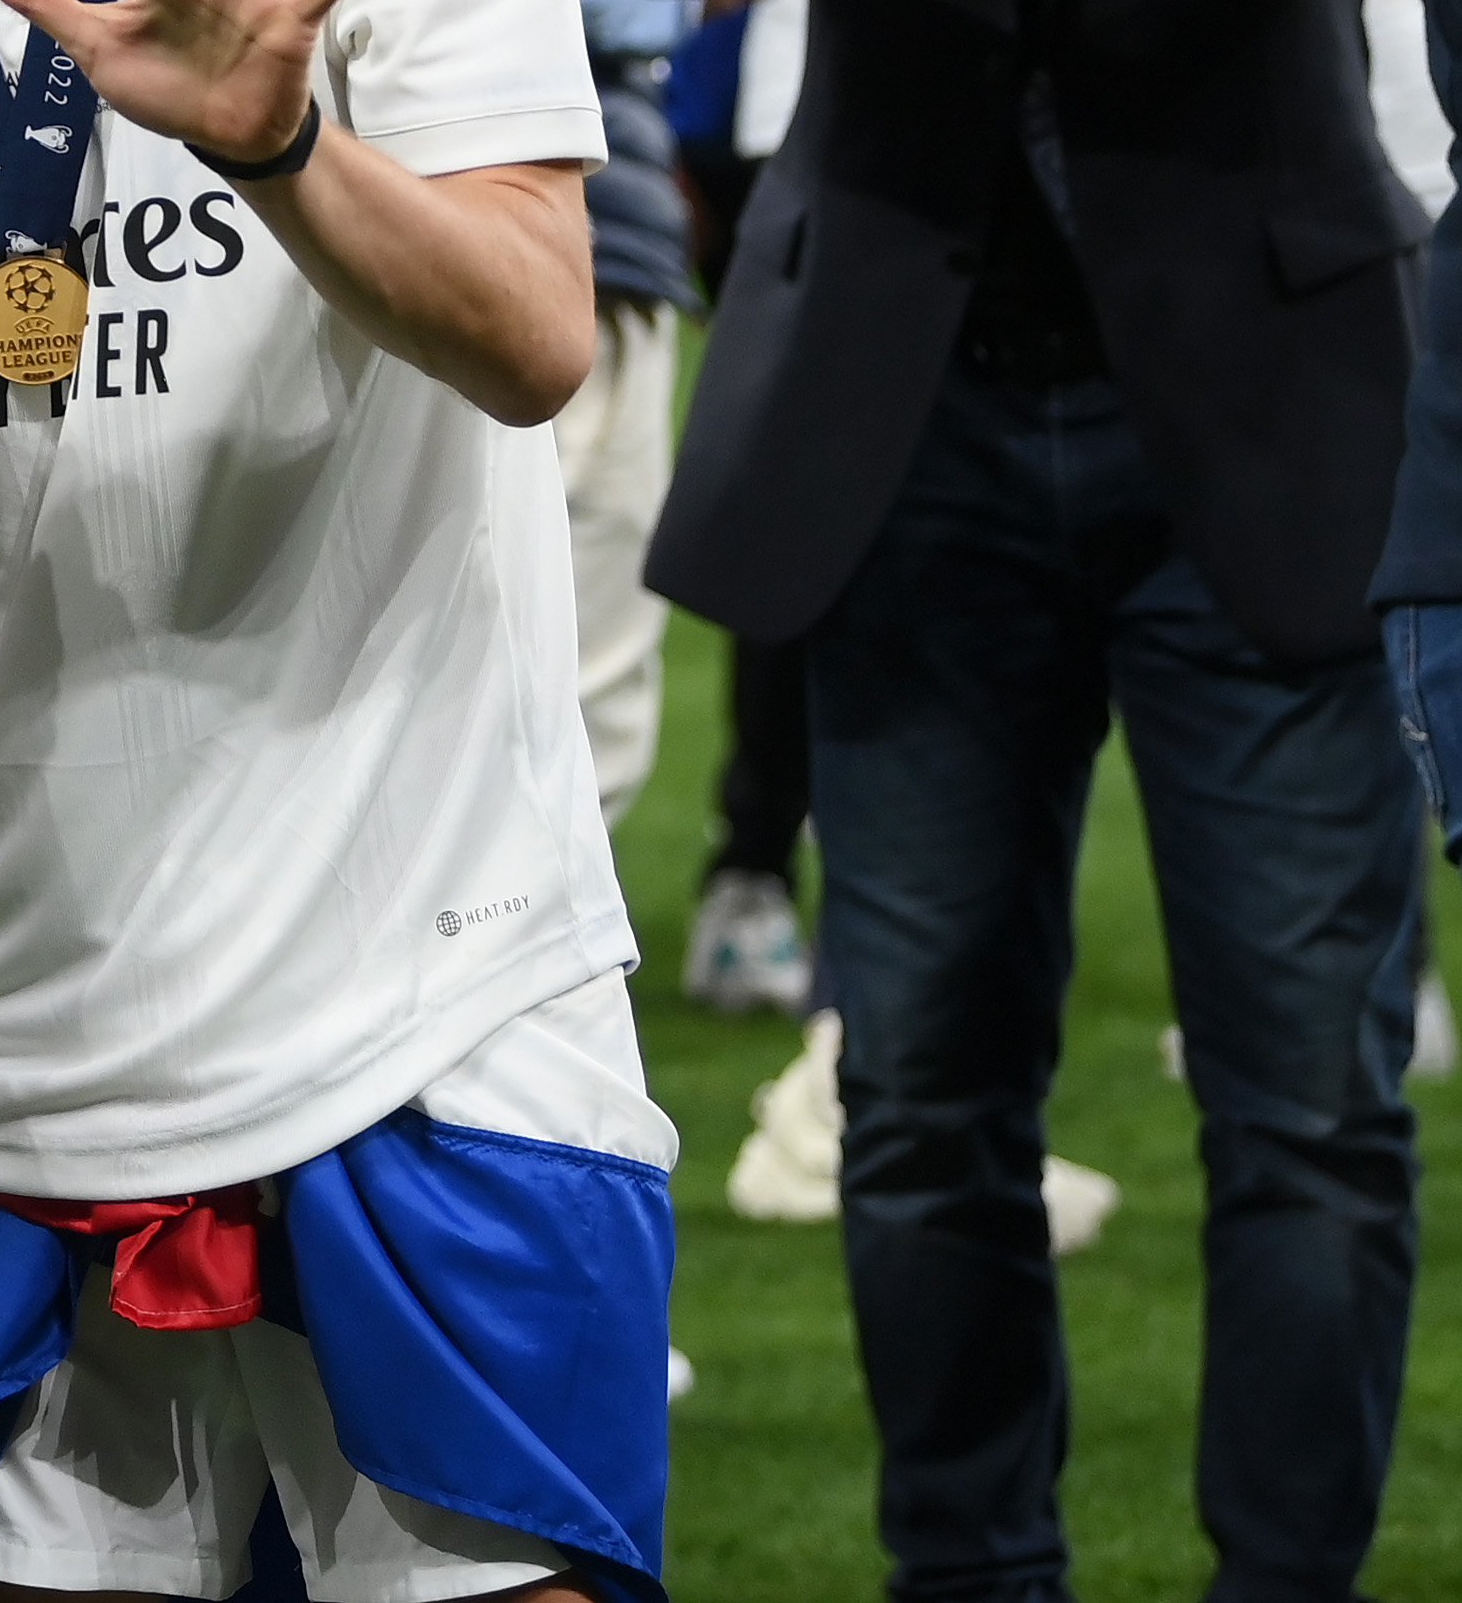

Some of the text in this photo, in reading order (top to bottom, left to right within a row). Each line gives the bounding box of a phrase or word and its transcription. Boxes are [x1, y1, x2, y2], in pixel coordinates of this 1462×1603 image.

[44, 42, 75, 105] 022
[2, 350, 73, 369] LEAGUE
[465, 895, 530, 926] HEAT.RDY
